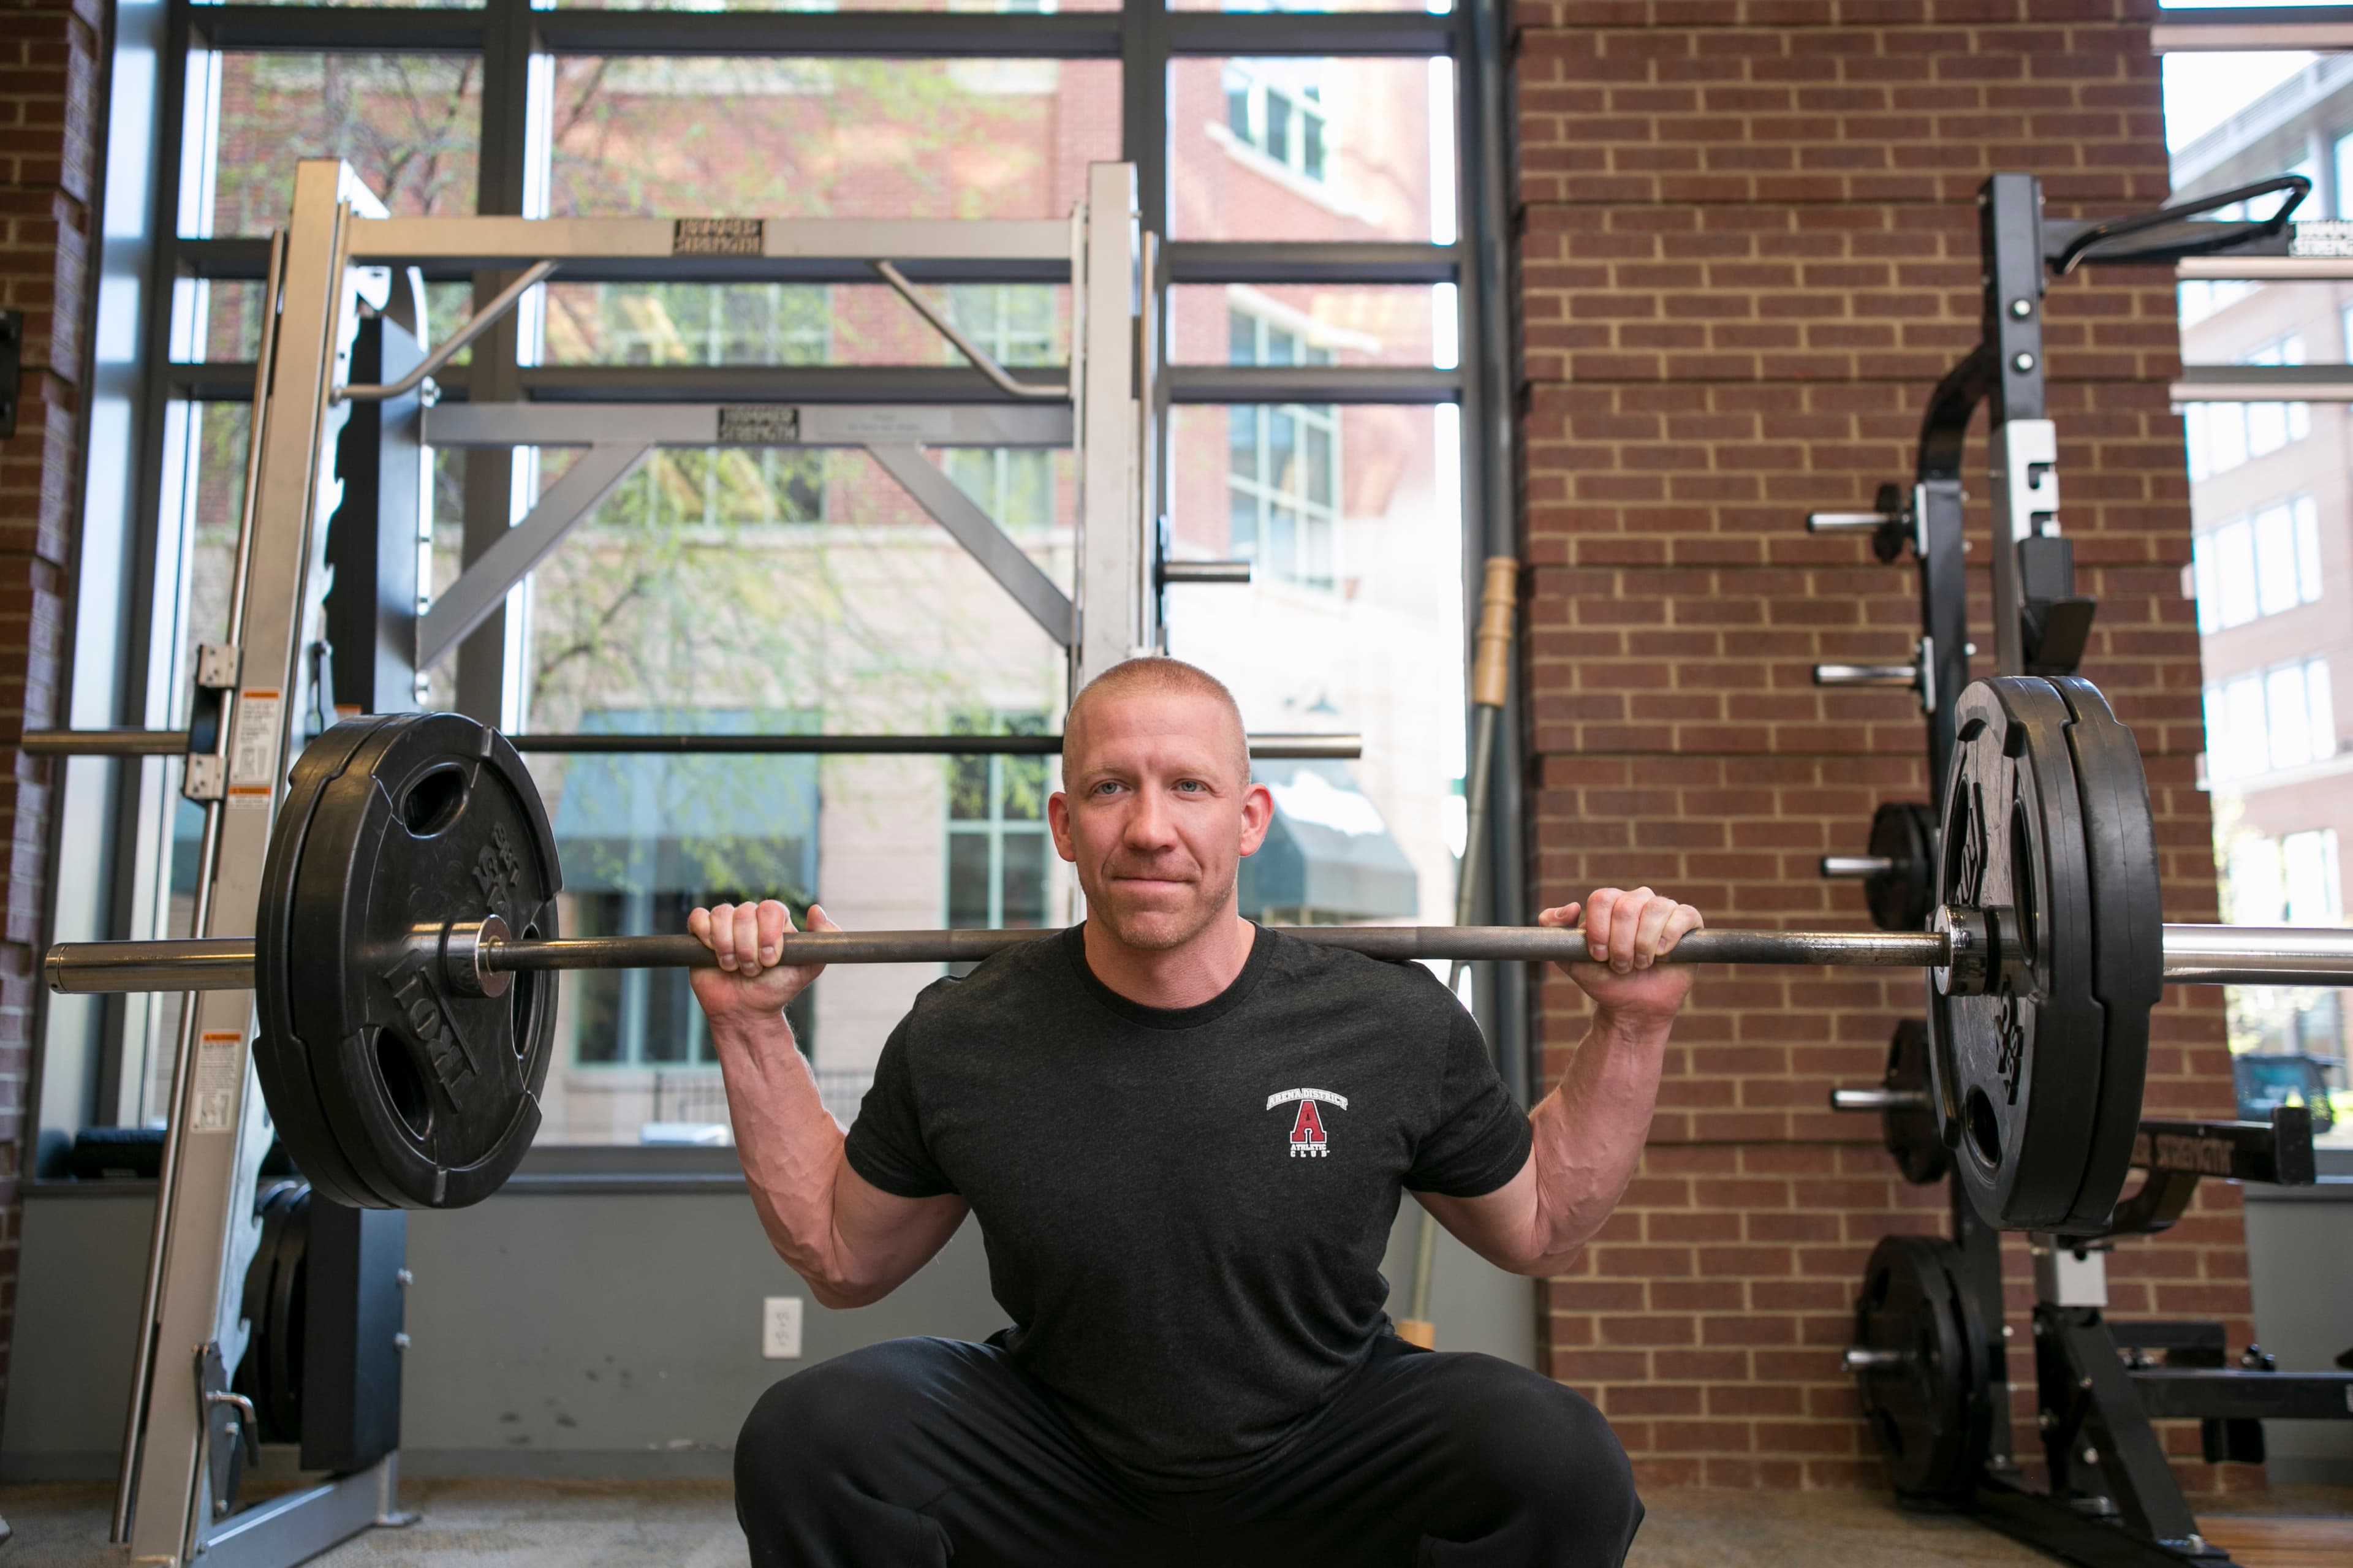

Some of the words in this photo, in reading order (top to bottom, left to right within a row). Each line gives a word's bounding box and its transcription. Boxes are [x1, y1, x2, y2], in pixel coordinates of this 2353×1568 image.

[1266, 1088, 1302, 1111] ARENA
[1302, 1088, 1348, 1111] DISTRICT
[1290, 1099, 1327, 1144] A
